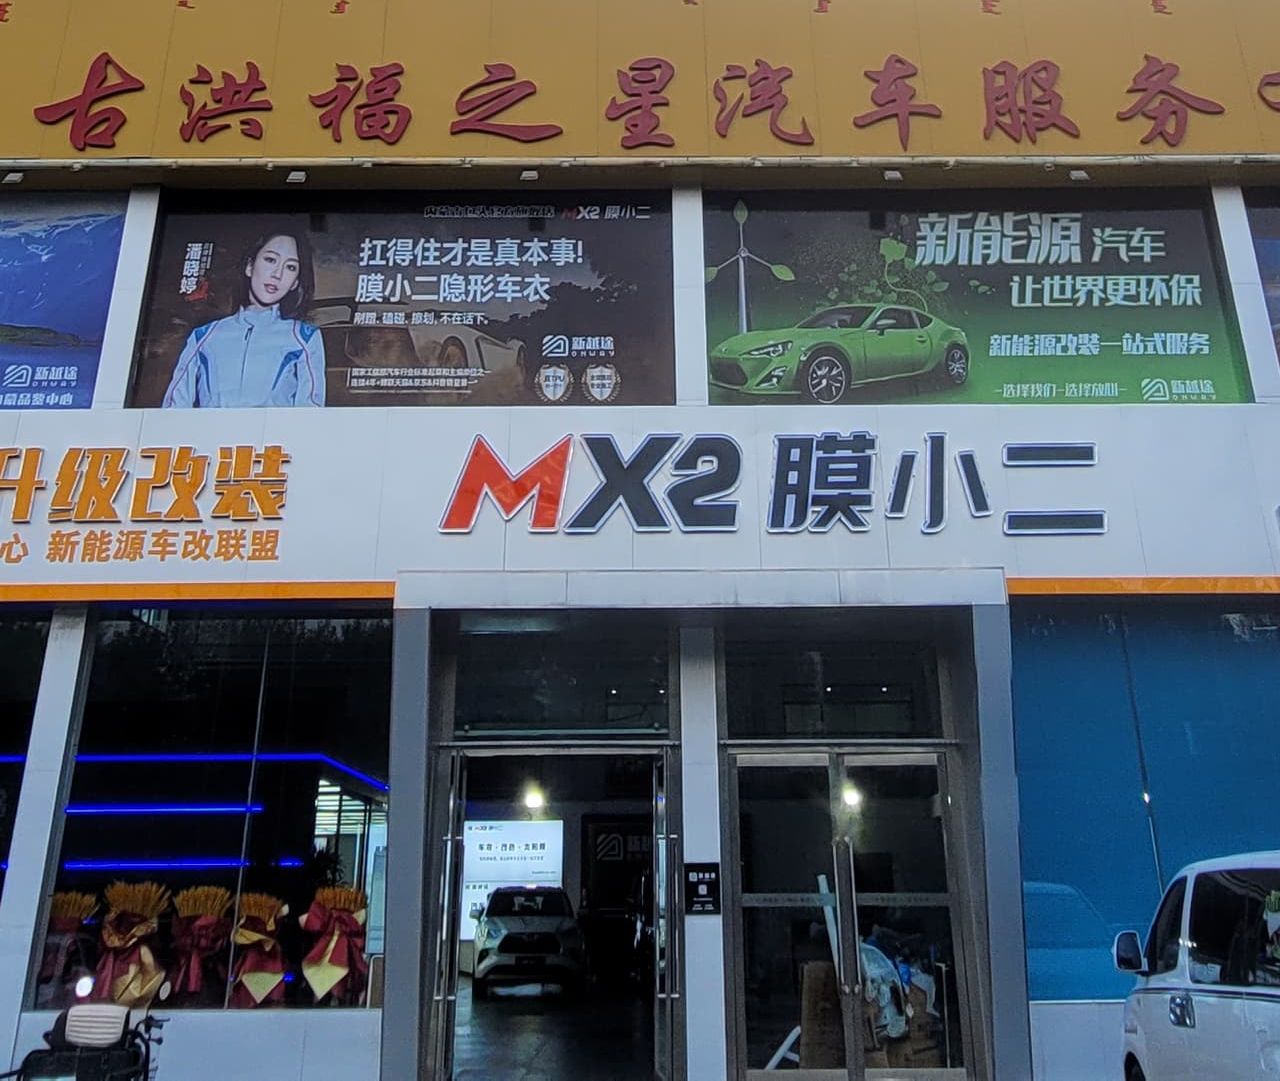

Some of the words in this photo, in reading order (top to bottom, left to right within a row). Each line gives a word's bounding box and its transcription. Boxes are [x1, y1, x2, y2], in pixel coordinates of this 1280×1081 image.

[358, 236, 584, 268] 扛得住才是真本事!
[915, 211, 1082, 268] 新能源
[1091, 227, 1167, 263] 汽车
[354, 272, 553, 304] 膜小二隐形车衣
[1010, 273, 1204, 308] 让世界更环保
[989, 332, 1212, 358] 新能源改装一站式服务
[437, 432, 744, 534] MX2
[765, 431, 1110, 535] 膜小二
[46, 529, 282, 564] 新能源车改联盟
